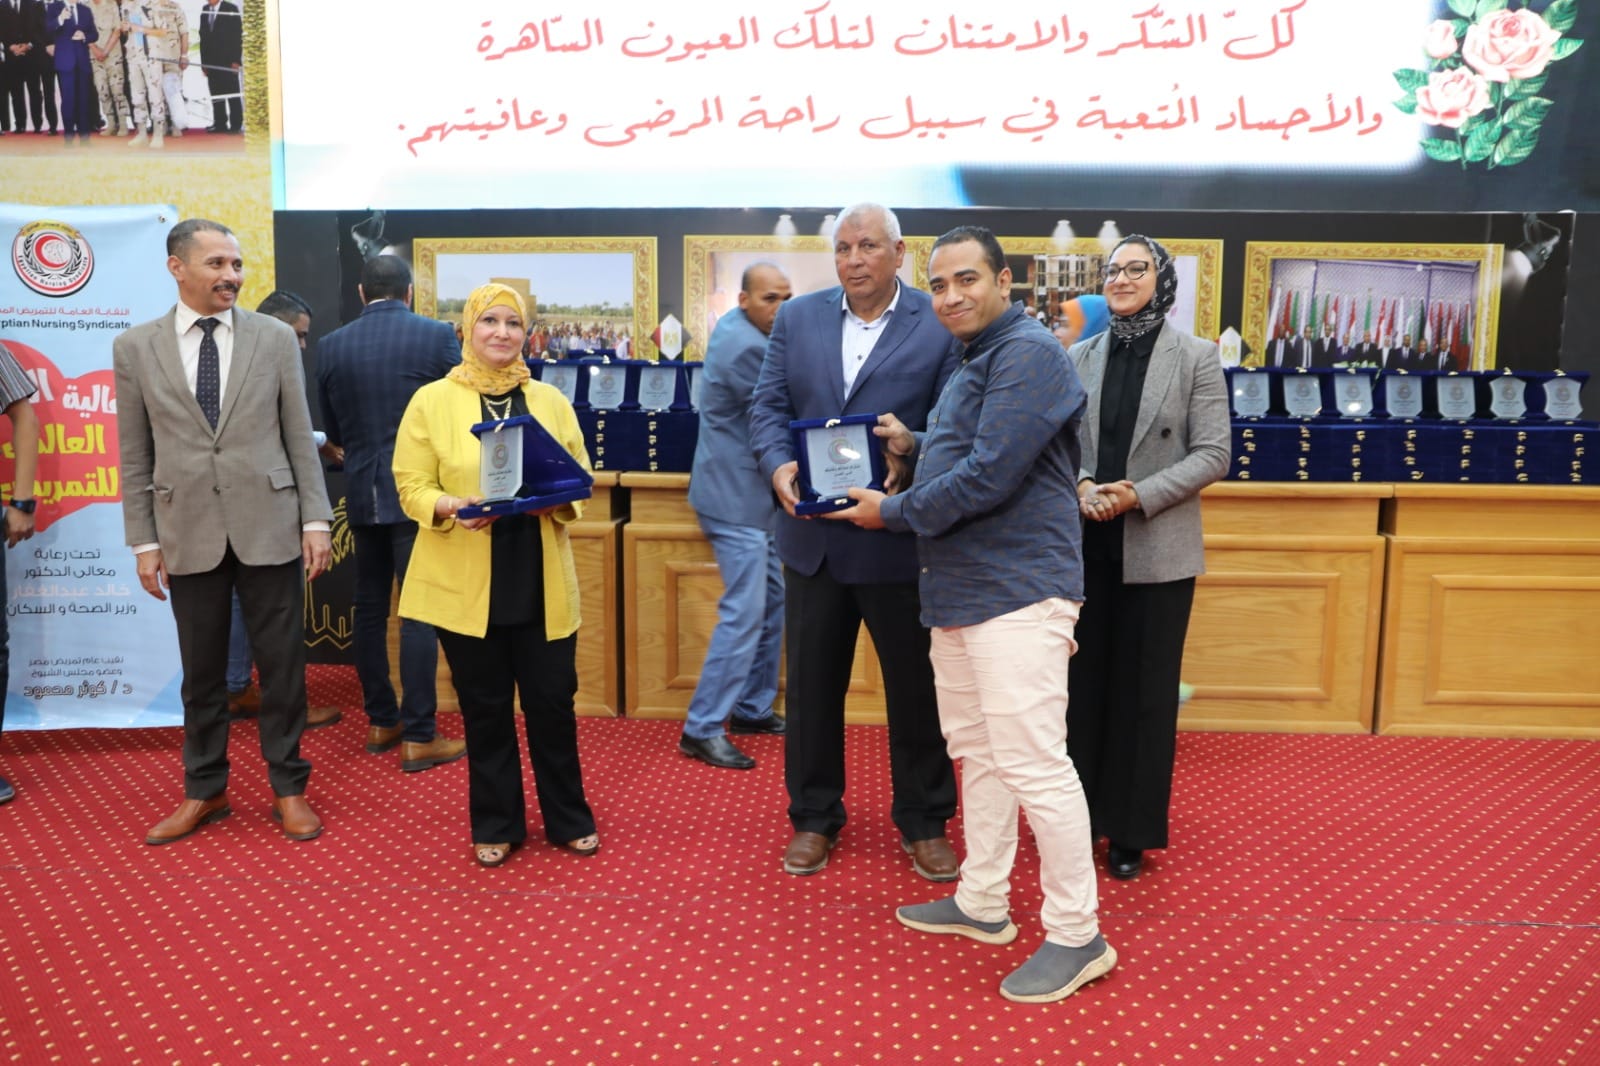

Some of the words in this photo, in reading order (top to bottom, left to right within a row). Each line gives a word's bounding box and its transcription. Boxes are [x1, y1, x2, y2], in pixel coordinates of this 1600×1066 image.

[774, 1, 874, 49] لتلك
[621, 16, 759, 62] العيون
[894, 15, 1088, 55] والامتنان
[584, 96, 723, 147] المرضى
[738, 96, 839, 133] راحة
[859, 96, 985, 139] سبيل
[1002, 97, 1059, 142] في
[1216, 93, 1384, 140] والأجساد
[0, 319, 30, 329] ptian
[32, 320, 76, 331] Nursing
[77, 320, 131, 331] Syndicate
[34, 548, 67, 561] رعاية
[69, 549, 101, 560] تحت
[24, 566, 71, 579] الدكتور
[6, 603, 55, 617] السكان
[68, 602, 111, 614] الصحة
[115, 603, 137, 615] وزير
[23, 685, 74, 700] محمود
[76, 680, 107, 698] كوثر
